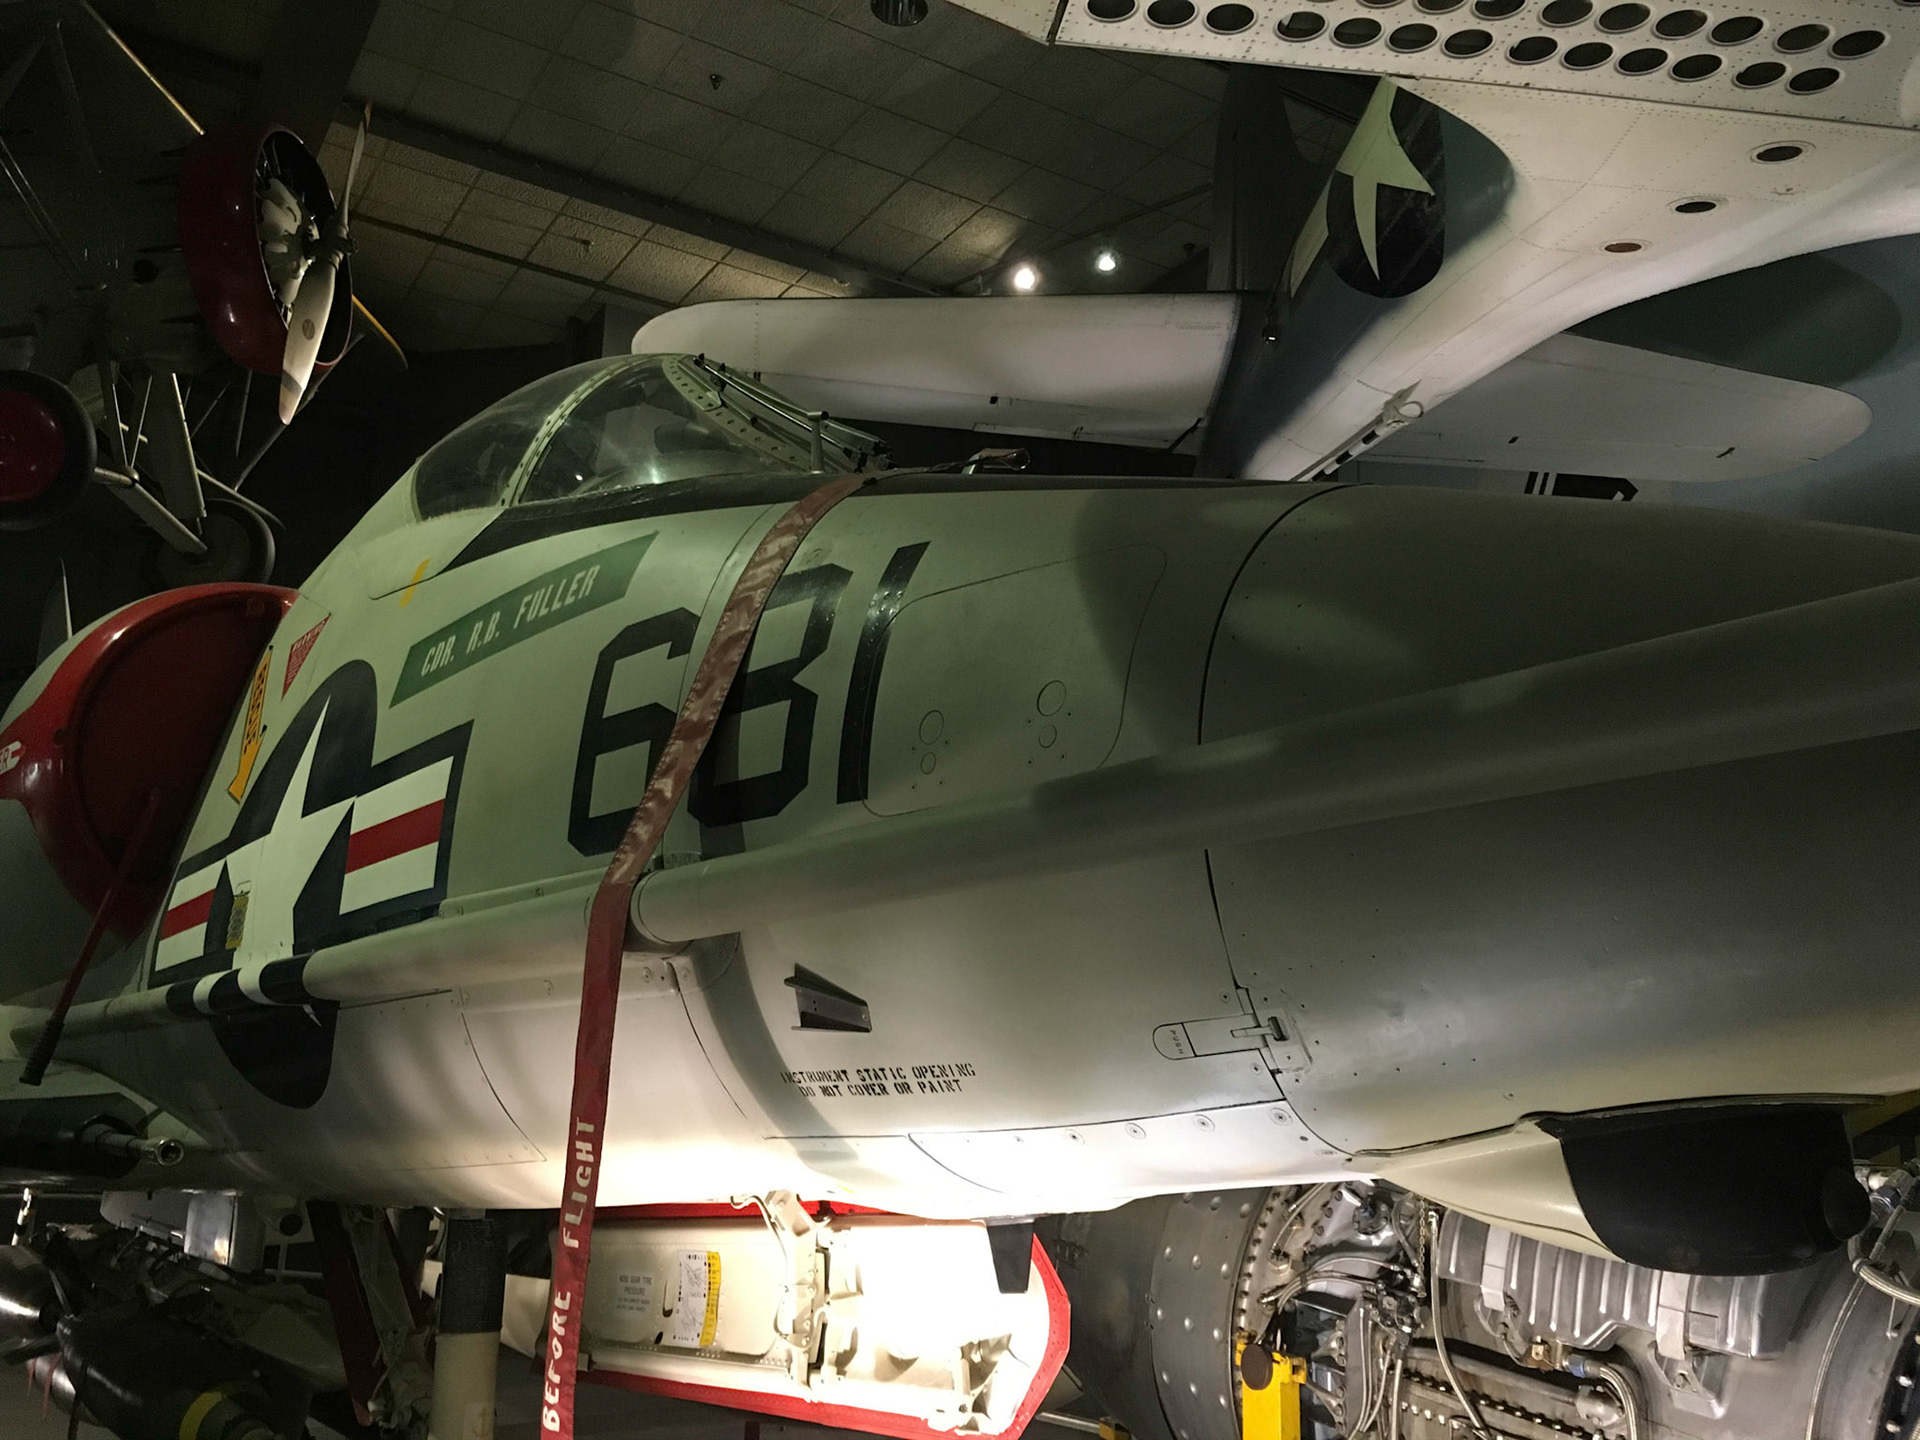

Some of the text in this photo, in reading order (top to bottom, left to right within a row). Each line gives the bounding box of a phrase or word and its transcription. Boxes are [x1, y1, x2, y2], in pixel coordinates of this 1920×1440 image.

[421, 565, 600, 677] CDR. R.B. FULLER
[568, 541, 931, 857] 681
[780, 1063, 976, 1084] INSTRUMENT STATIC OPENING
[1170, 1029, 1185, 1055] PUSH
[798, 1079, 963, 1098] DO NOT COVER OR PAINT
[543, 1117, 595, 1433] BEFORE FLIGHT
